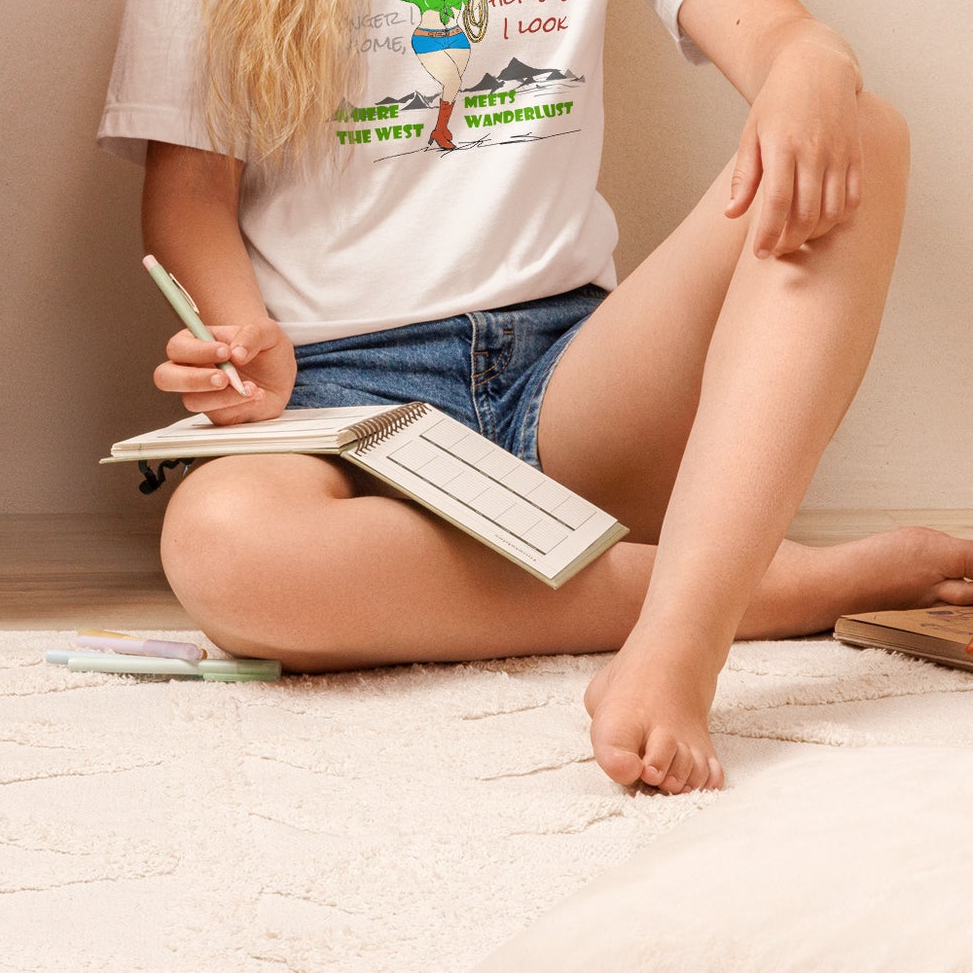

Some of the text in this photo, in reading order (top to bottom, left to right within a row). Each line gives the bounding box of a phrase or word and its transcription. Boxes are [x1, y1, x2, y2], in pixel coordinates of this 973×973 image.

[350, 6, 415, 30] NGER I
[503, 15, 569, 40] I LOOK
[464, 89, 516, 109] MEETS
[464, 101, 574, 128] WANDERLUST
[336, 123, 425, 145] THE WEST
